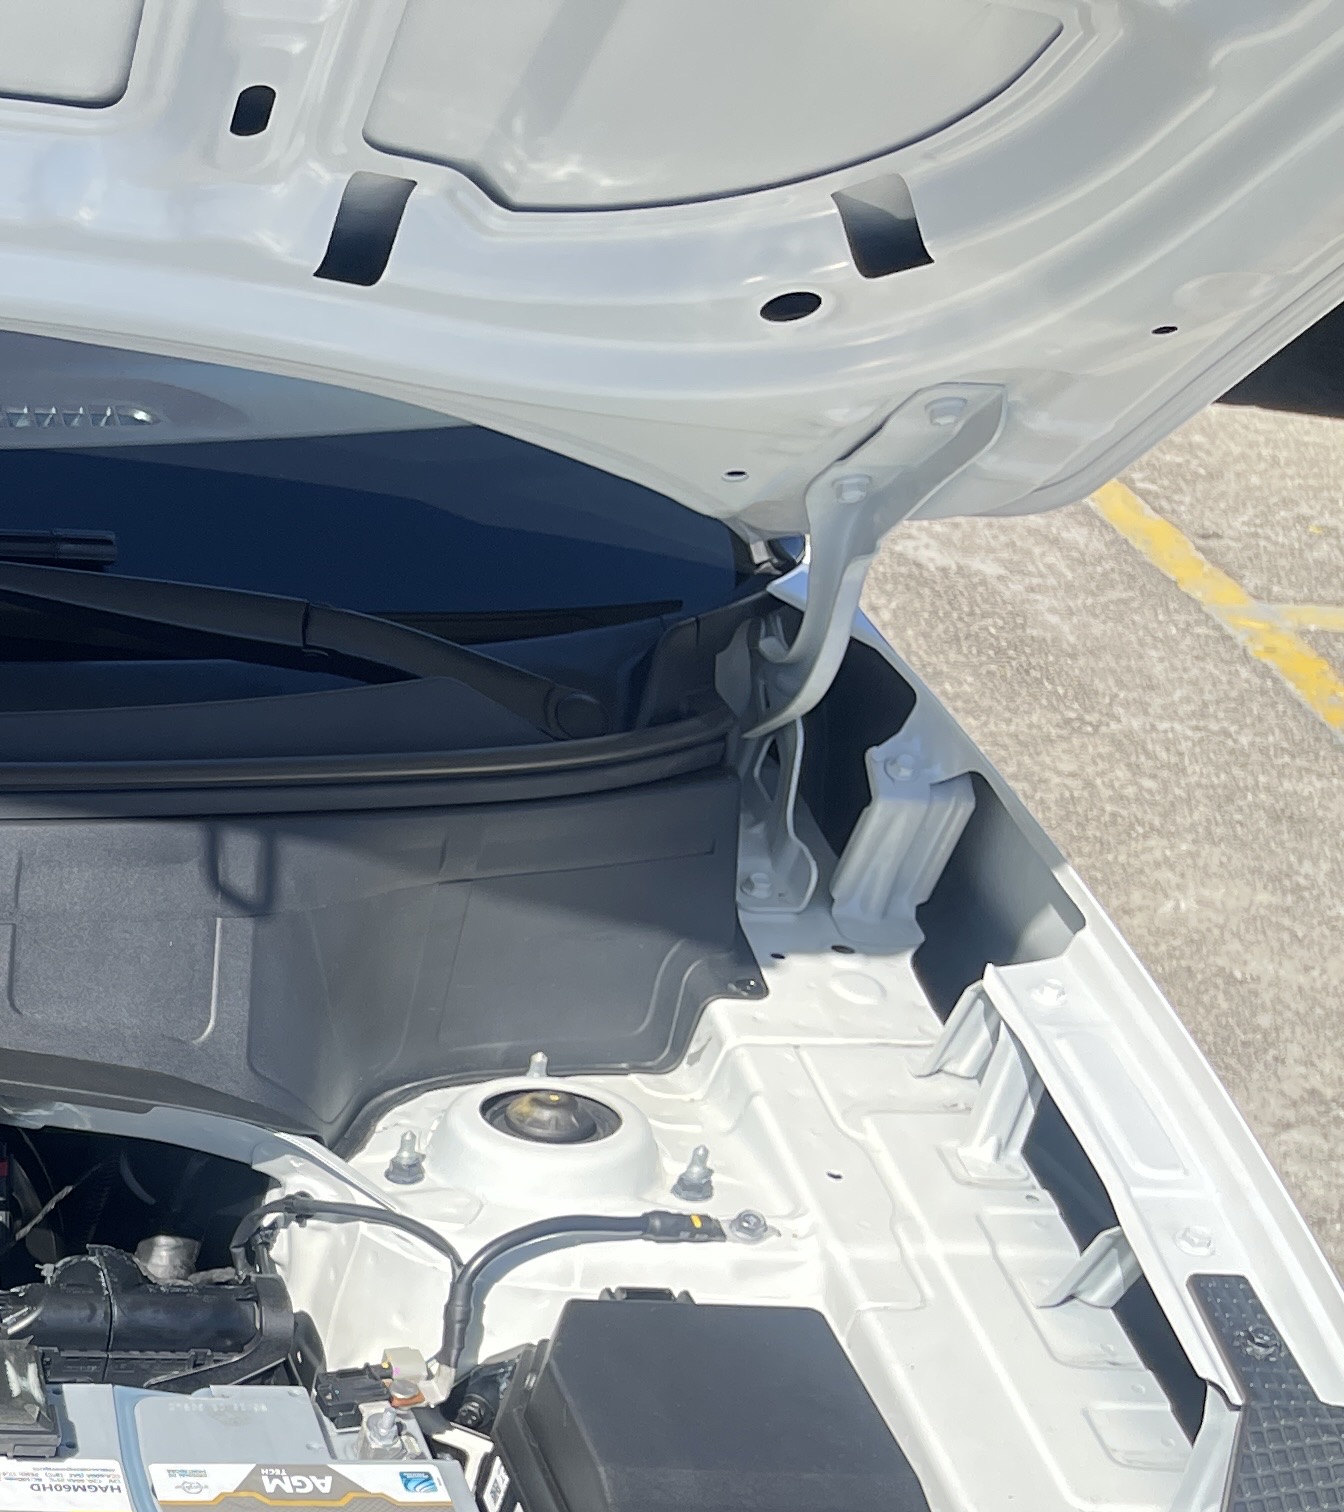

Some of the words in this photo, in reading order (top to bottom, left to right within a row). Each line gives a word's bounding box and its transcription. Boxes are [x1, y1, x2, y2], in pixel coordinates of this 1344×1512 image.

[260, 1467, 287, 1476] TECH
[29, 1483, 122, 1494] HAGM60HD
[261, 1473, 333, 1494] AGM
